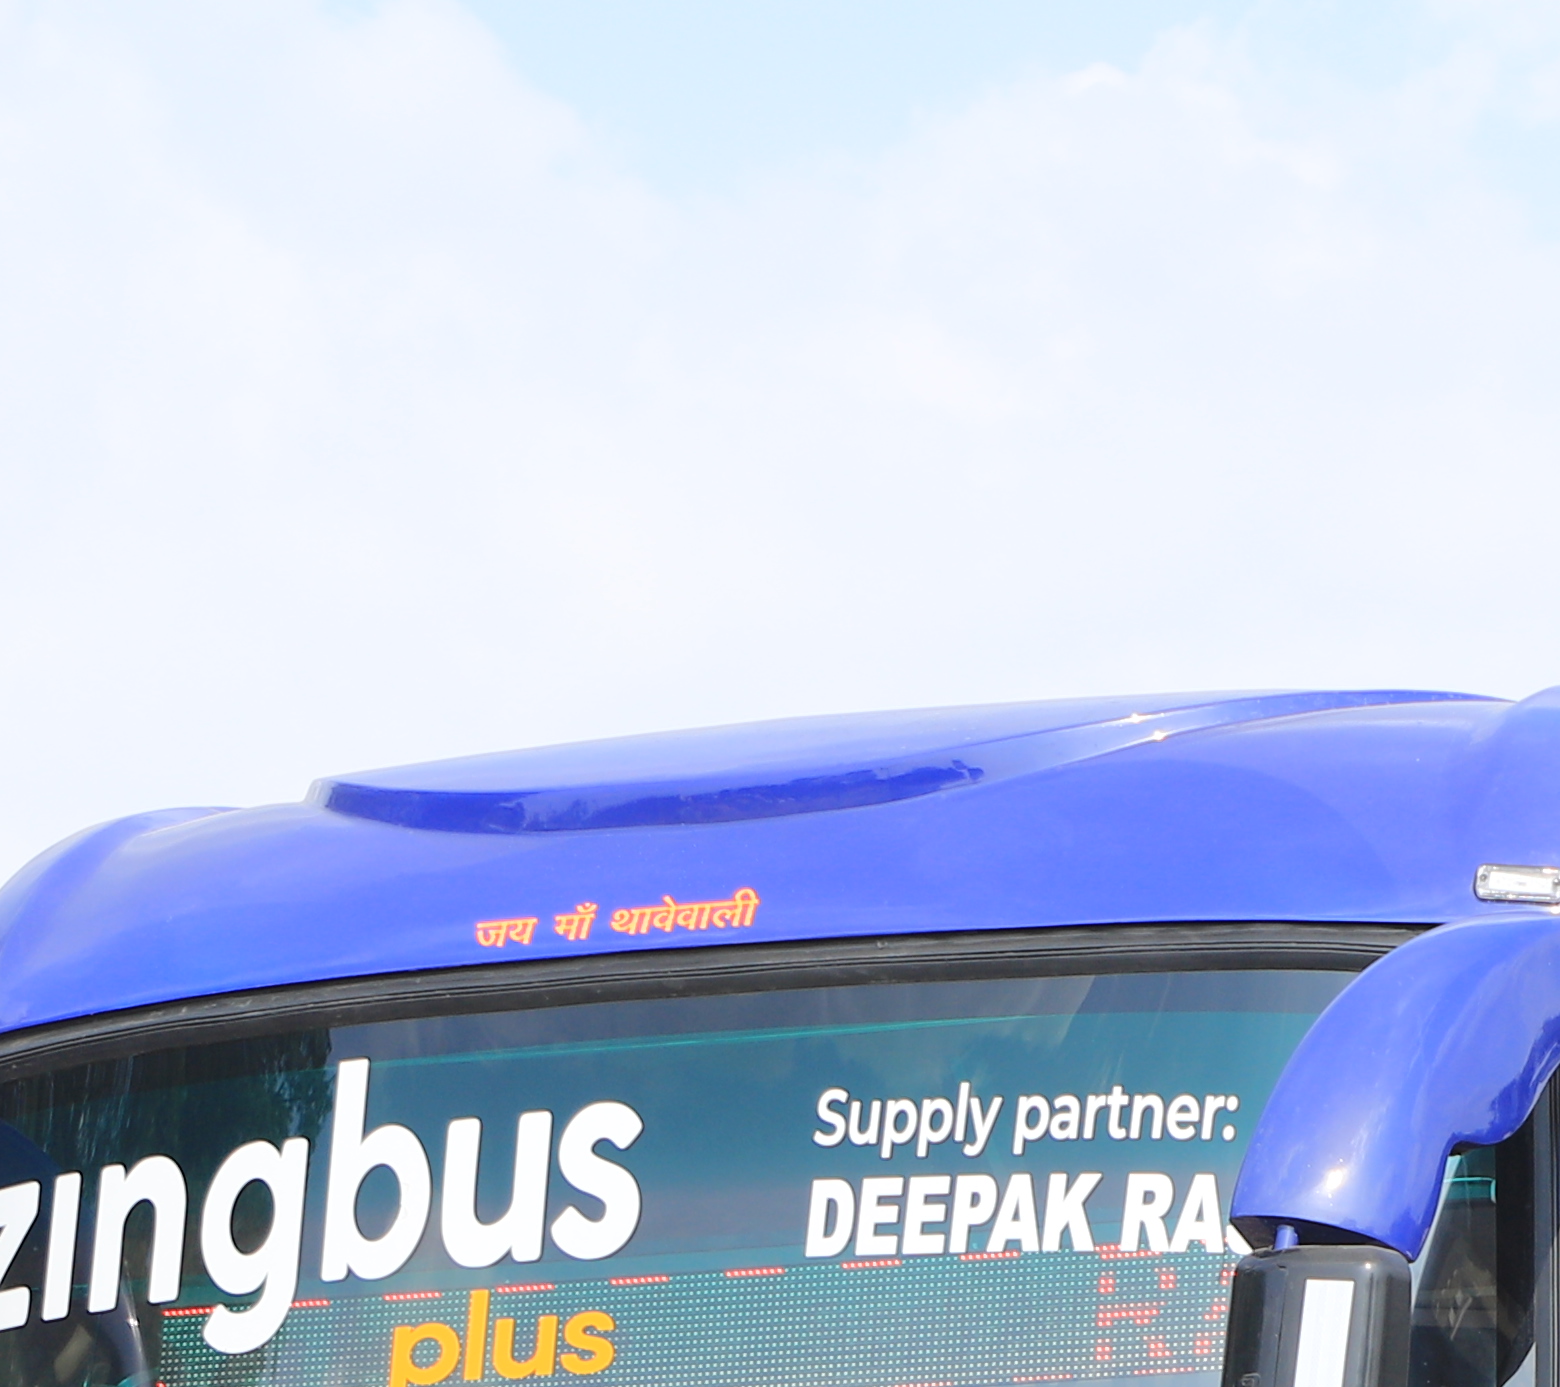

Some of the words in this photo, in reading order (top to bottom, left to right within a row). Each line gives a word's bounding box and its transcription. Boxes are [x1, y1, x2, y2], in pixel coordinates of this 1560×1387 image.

[474, 915, 540, 949] जय
[553, 900, 600, 942] माँ
[812, 1080, 1003, 1160] Supply
[1011, 1085, 1239, 1156] partner:
[804, 1172, 1103, 1258] DEEPAK
[1117, 1172, 1254, 1256] RA
